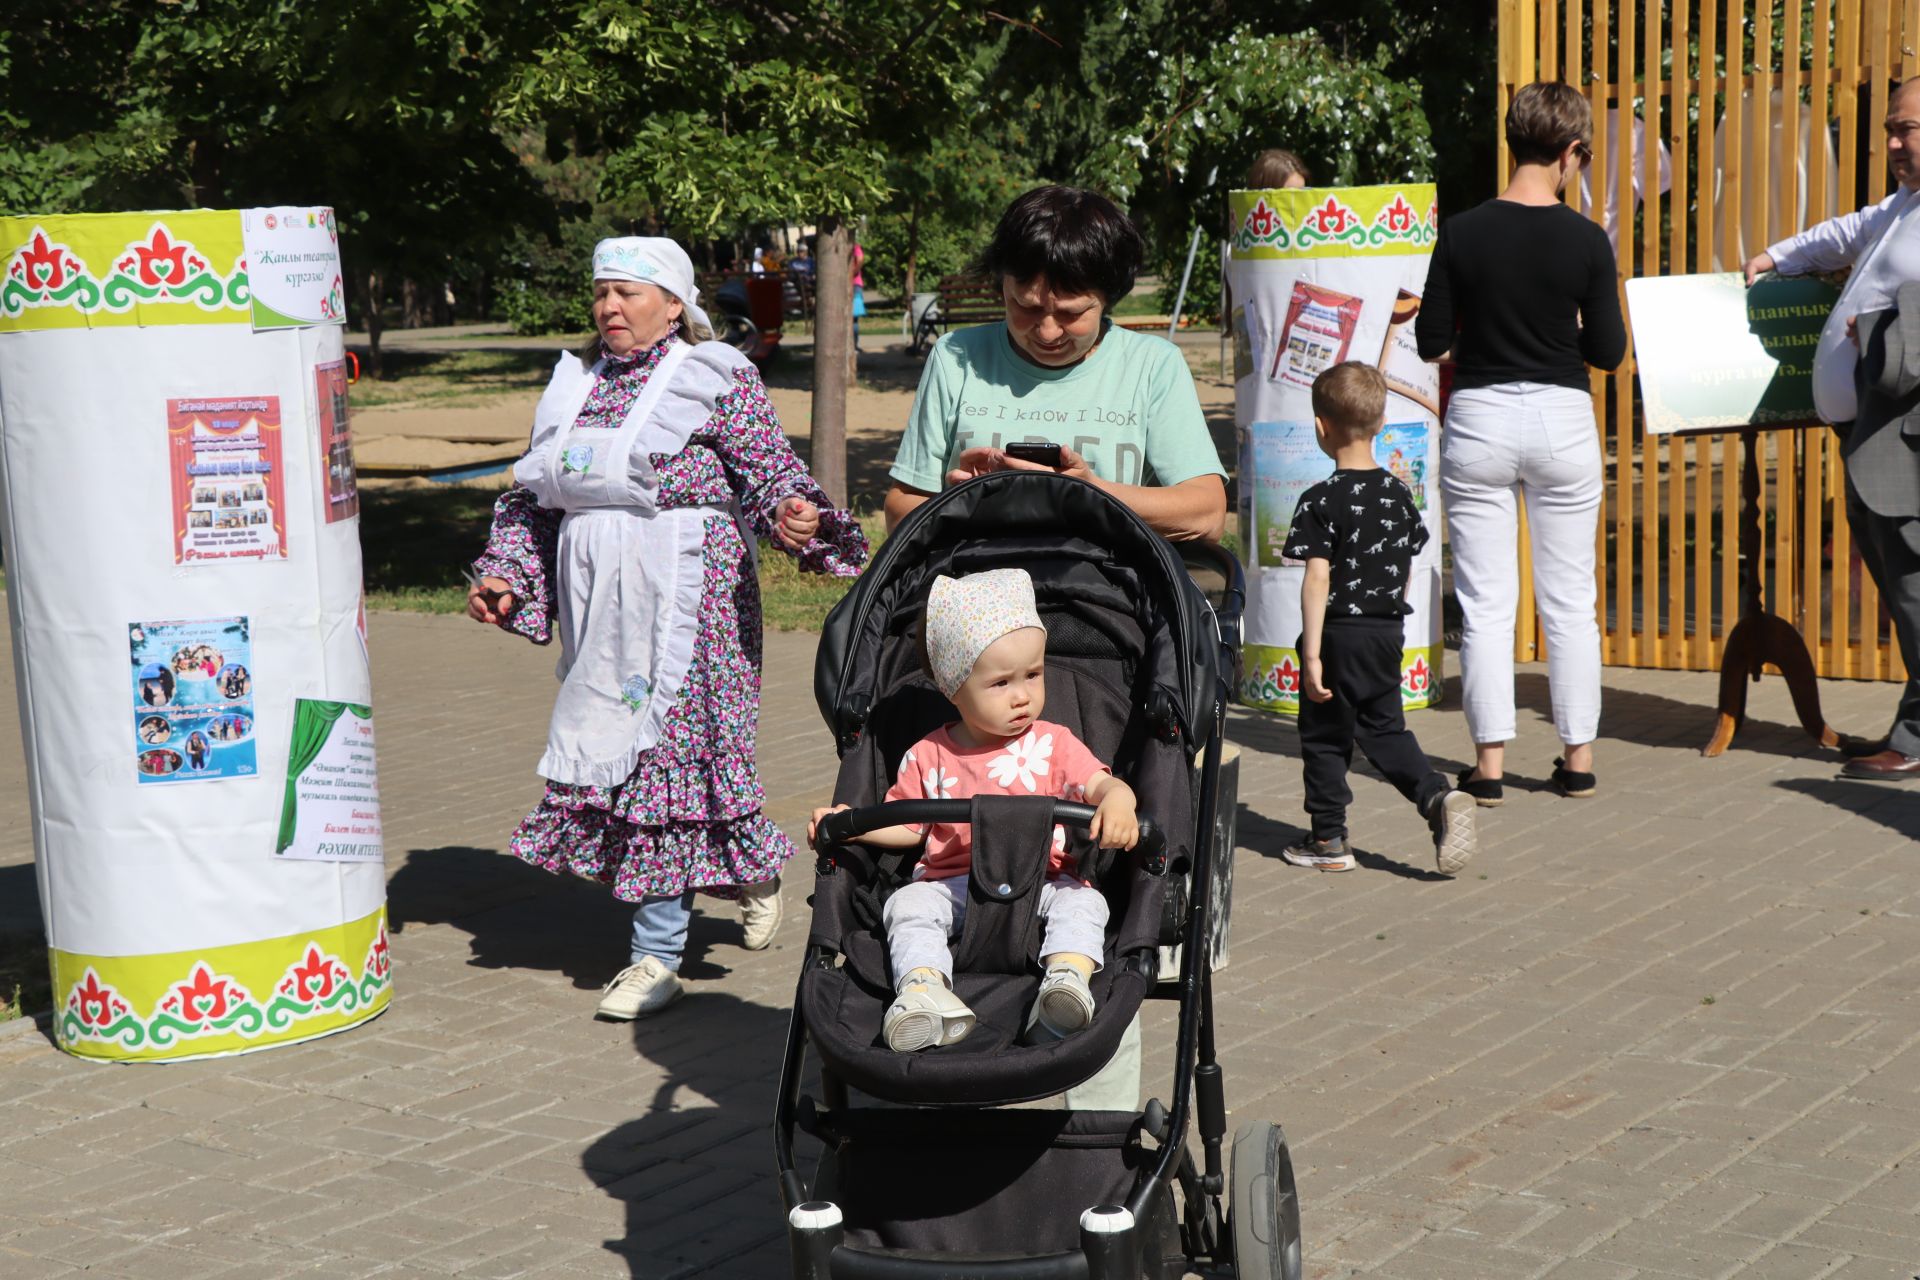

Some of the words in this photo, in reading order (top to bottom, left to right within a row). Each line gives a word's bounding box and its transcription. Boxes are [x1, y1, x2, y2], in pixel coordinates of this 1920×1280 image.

[958, 400, 989, 417] Yes
[995, 406, 1007, 419] I
[1015, 407, 1068, 423] know
[1077, 409, 1087, 422] I
[1094, 406, 1137, 426] look
[324, 823, 349, 834] Билет
[317, 842, 357, 856] РӘХИМ
